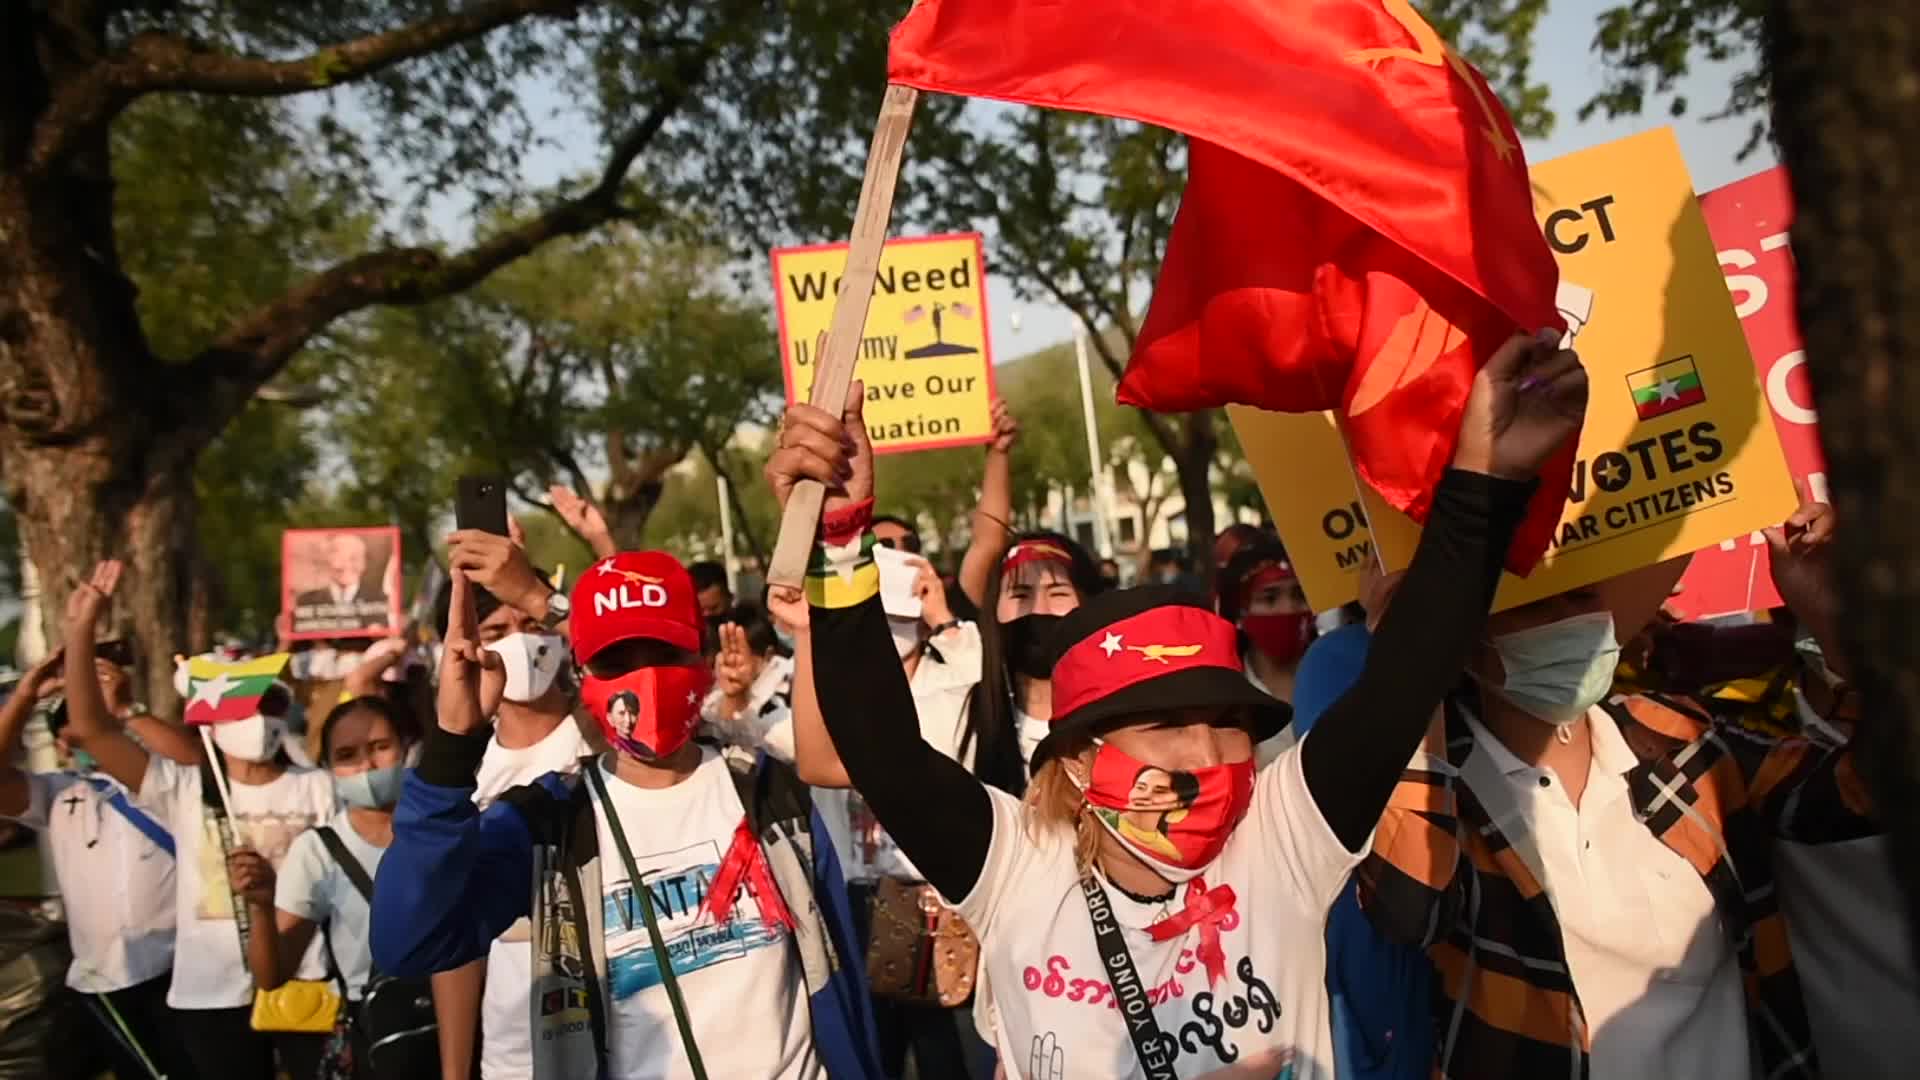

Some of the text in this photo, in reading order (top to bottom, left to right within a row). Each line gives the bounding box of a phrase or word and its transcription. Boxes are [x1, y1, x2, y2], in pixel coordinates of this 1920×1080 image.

[1543, 193, 1616, 254] CT
[871, 258, 970, 296] Need
[863, 336, 898, 361] my
[867, 375, 976, 401] ave Our
[871, 414, 961, 440] uation
[1551, 472, 1734, 548] AR CITIZENS
[1335, 541, 1370, 569] MY
[594, 584, 667, 616] NLD
[1083, 872, 1116, 936] FORE
[1108, 952, 1151, 1031] YOUNG
